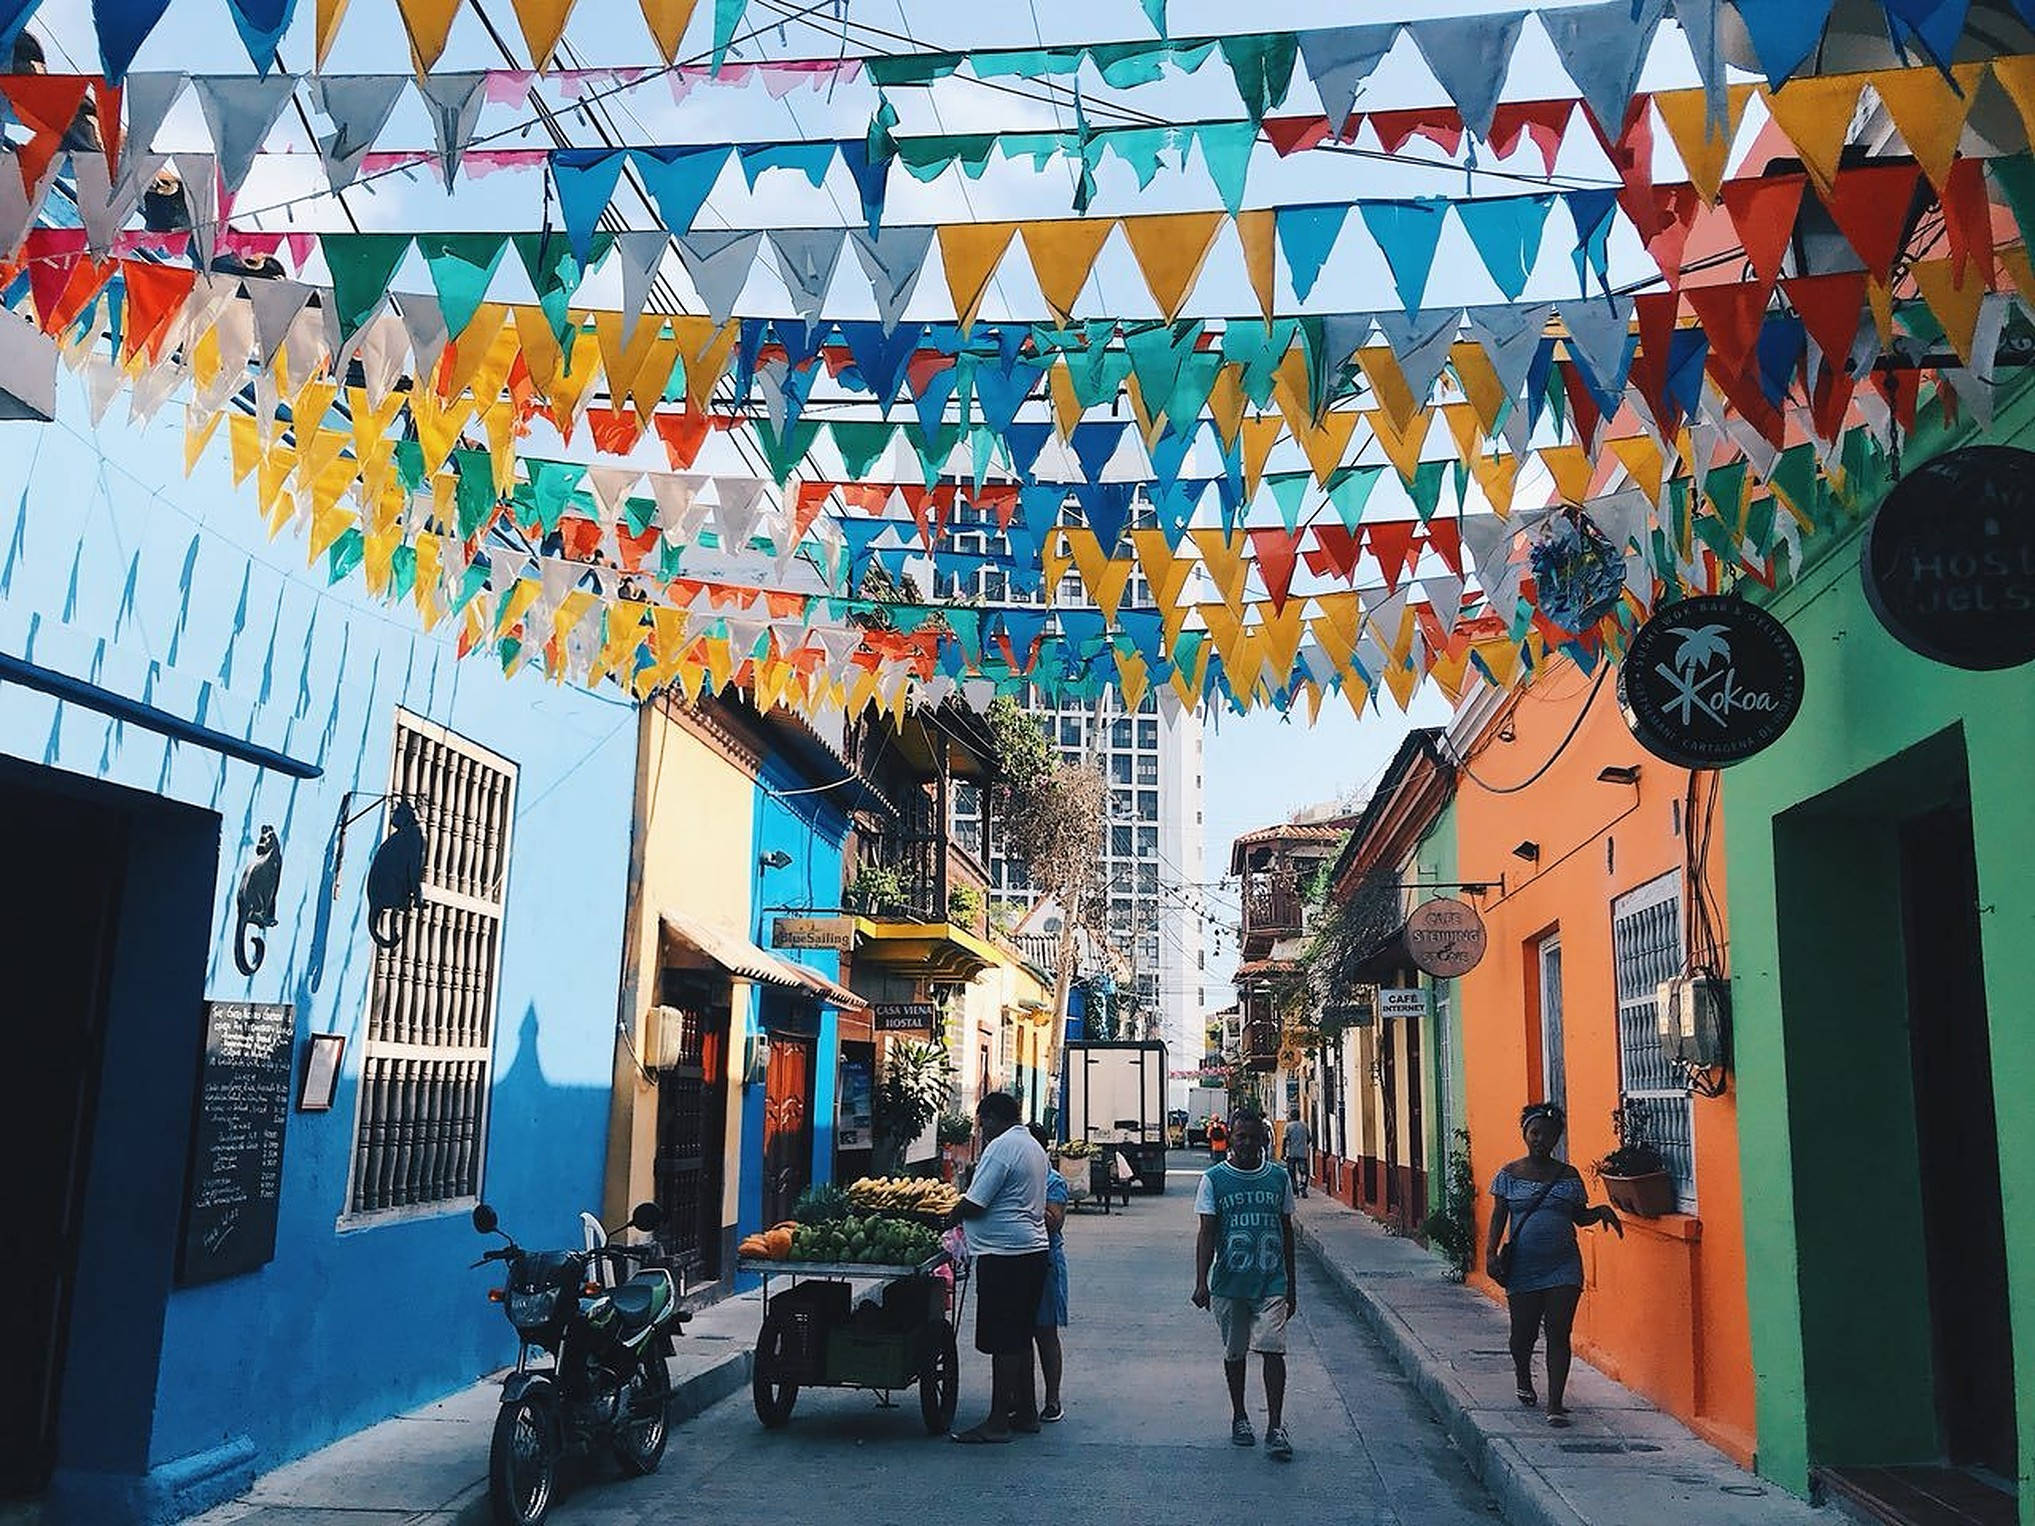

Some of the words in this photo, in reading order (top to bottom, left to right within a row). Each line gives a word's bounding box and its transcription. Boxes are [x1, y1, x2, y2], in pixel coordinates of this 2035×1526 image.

[1655, 662, 1780, 728] Kokoa
[876, 1005, 901, 1015] CASA
[903, 1005, 933, 1015] VIENA
[1382, 1004, 1425, 1012] INTERNET
[886, 1018, 923, 1028] HOSTAL
